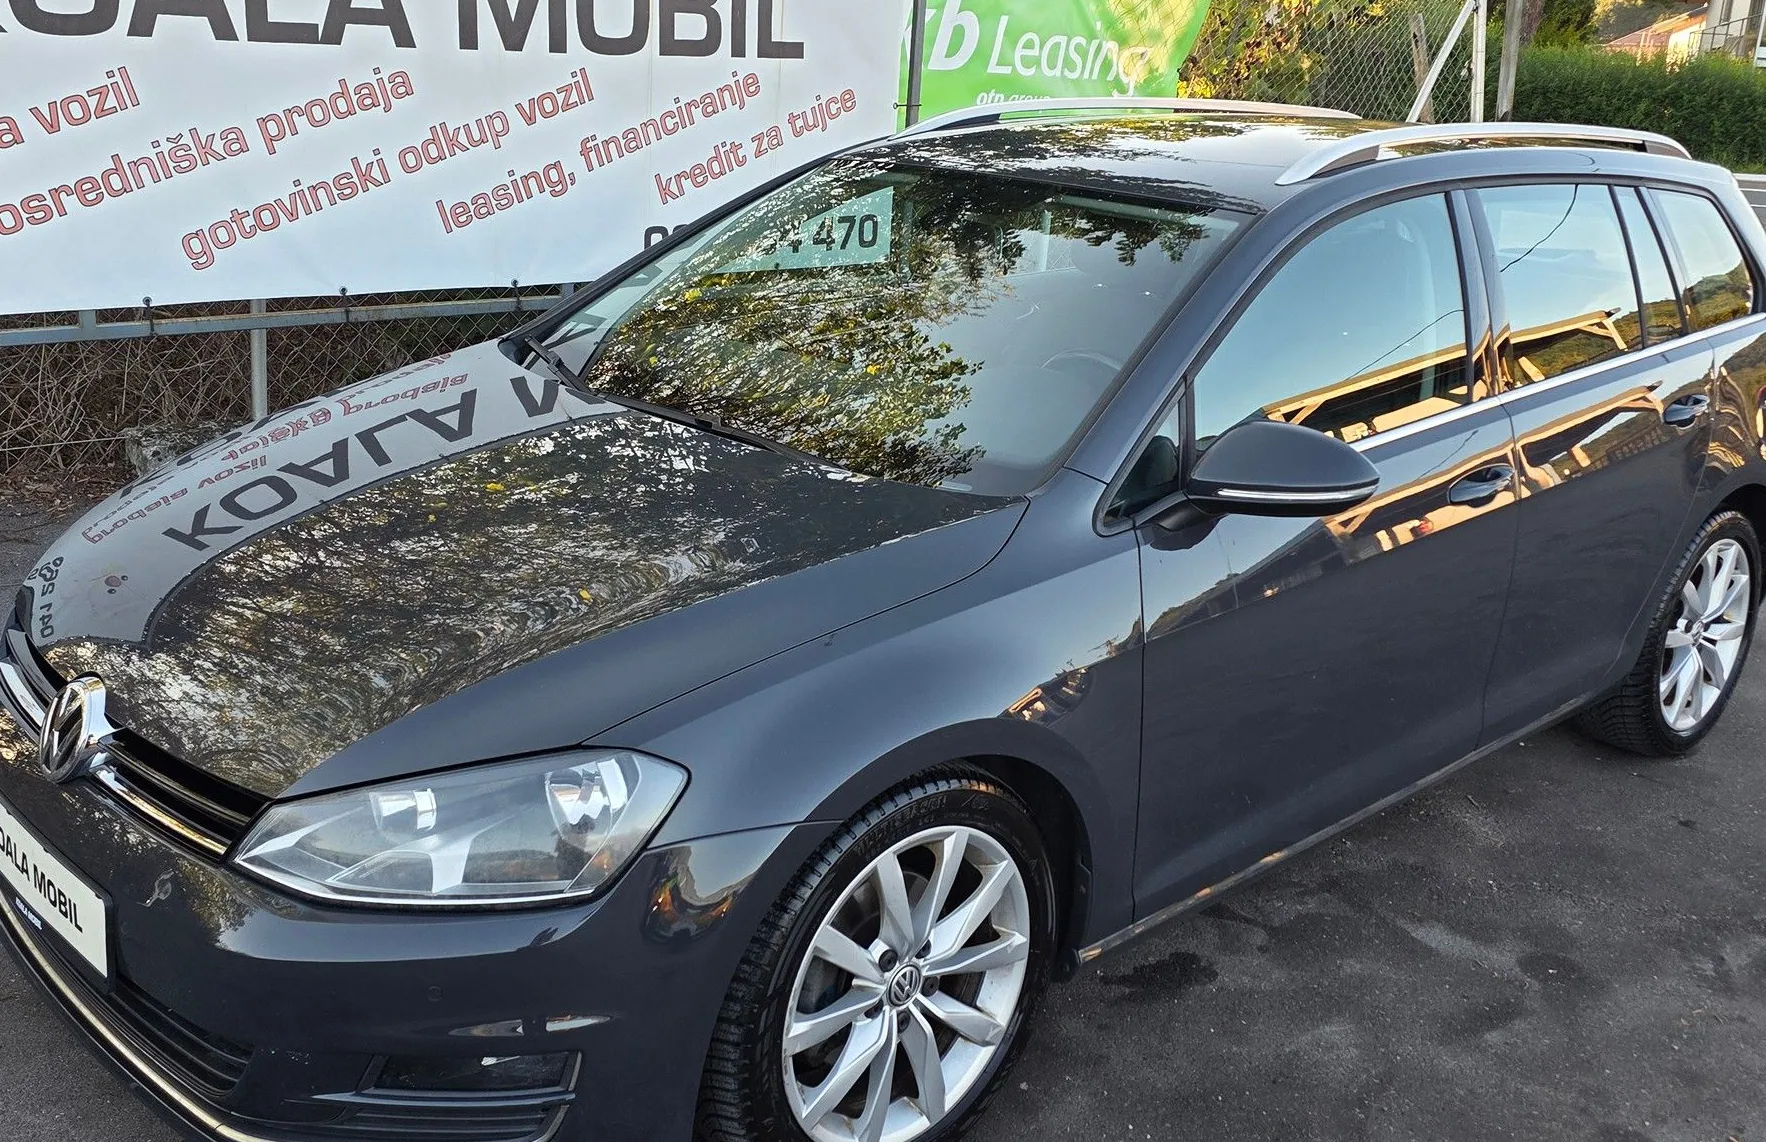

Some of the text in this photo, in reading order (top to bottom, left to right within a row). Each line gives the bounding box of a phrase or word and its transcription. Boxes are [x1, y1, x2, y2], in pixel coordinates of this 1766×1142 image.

[29, 66, 140, 135] vozil
[987, 14, 1152, 97] Leasing
[0, 67, 414, 236] osredniška prodaja
[181, 67, 595, 271] gotovinski odkup vozil
[436, 70, 761, 234] leasing, financiranje
[654, 88, 858, 205] kredit za tujce
[812, 213, 879, 252] 470
[33, 863, 83, 934] MOBIL
